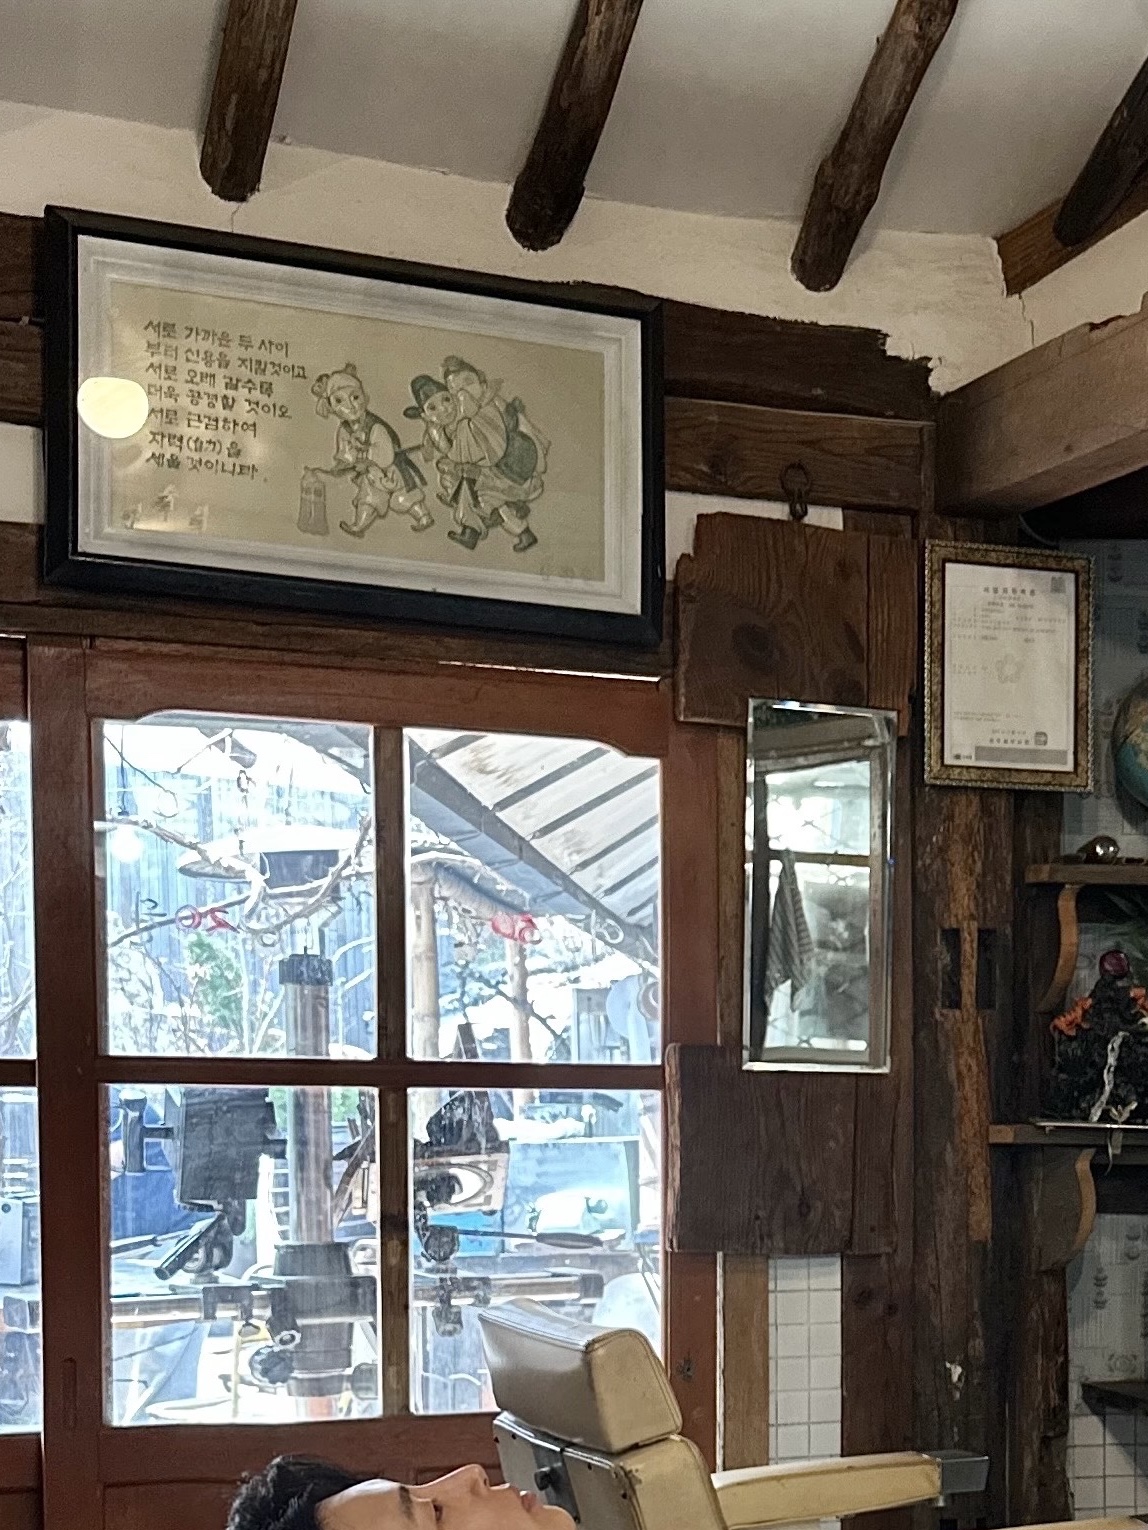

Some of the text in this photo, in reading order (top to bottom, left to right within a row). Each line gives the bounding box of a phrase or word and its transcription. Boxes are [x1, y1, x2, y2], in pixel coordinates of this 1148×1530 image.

[143, 320, 288, 358] 서로 가까운 두 사이
[145, 340, 178, 361] 부터
[184, 348, 231, 369] 신용을
[145, 362, 274, 398] 서로 오래 갈수록
[147, 383, 292, 419] 더욱 공경할 것이오
[148, 407, 257, 438] 서로 근검하여
[145, 452, 181, 469] 세울
